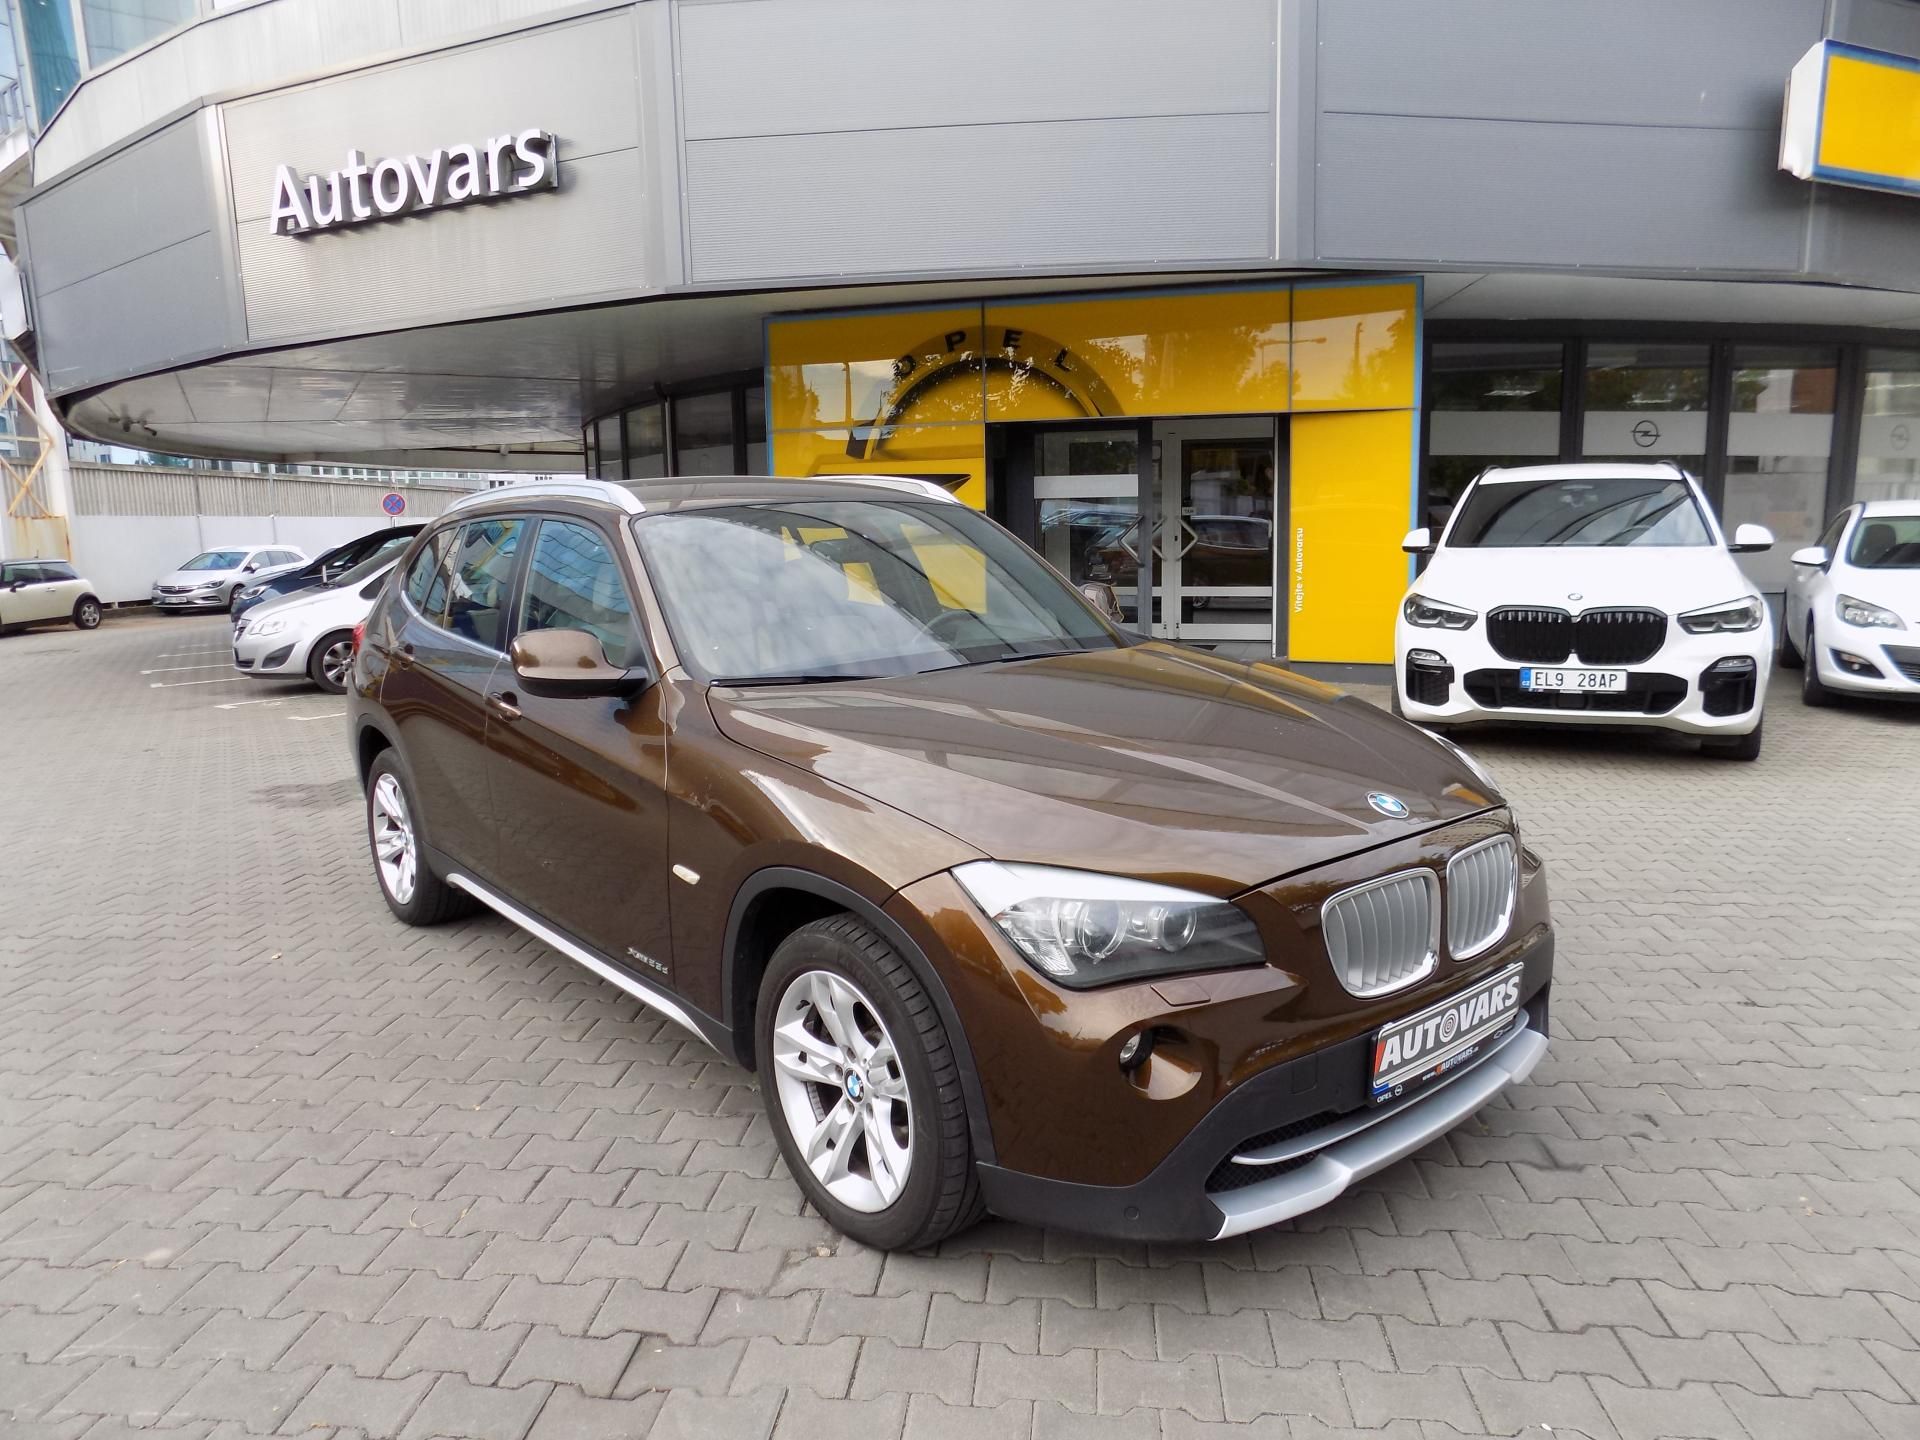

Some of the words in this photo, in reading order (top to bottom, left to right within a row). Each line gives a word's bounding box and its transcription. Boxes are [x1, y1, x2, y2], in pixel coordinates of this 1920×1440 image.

[270, 128, 551, 235] Autovars
[893, 328, 1072, 378] OPEL
[1295, 528, 1303, 574] Autovarsu
[1535, 672, 1564, 687] EL9
[1577, 673, 1618, 688] 28AP
[1379, 975, 1520, 1073] AUTOVARS
[1377, 1092, 1393, 1103] OPEL
